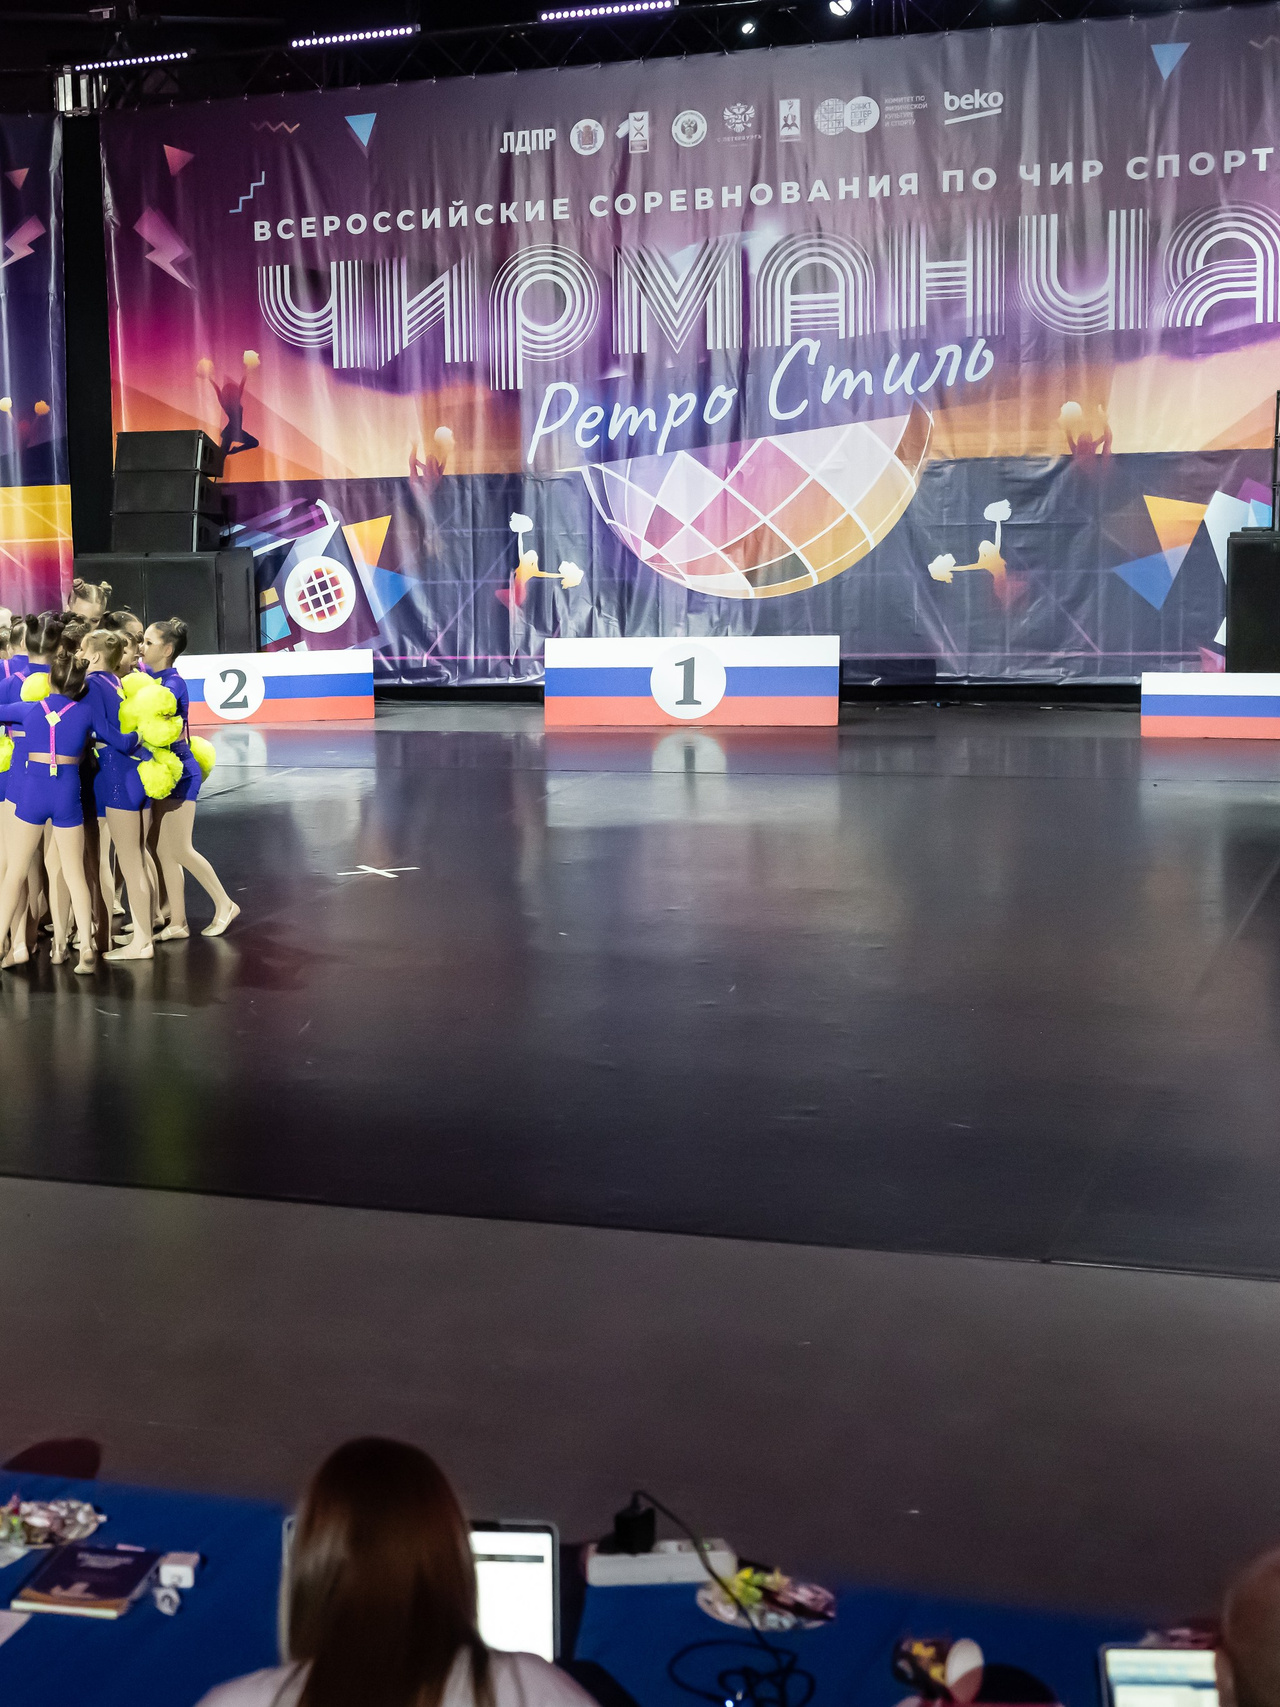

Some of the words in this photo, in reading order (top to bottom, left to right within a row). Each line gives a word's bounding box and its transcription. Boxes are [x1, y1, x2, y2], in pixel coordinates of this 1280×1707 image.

[943, 89, 1004, 112] beko
[499, 128, 557, 156] ЛДПР
[253, 198, 571, 241] ВСЕРОССИЙСКИЕ
[589, 172, 920, 219] СОРЕВНОВАНИЯ
[942, 166, 998, 193] ПО
[1020, 159, 1104, 186] ЧИР
[1125, 147, 1275, 181] СПОРТ
[527, 381, 738, 465] Ретро
[767, 337, 995, 422] Стиль
[219, 668, 249, 710] 2
[674, 656, 703, 706] 1
